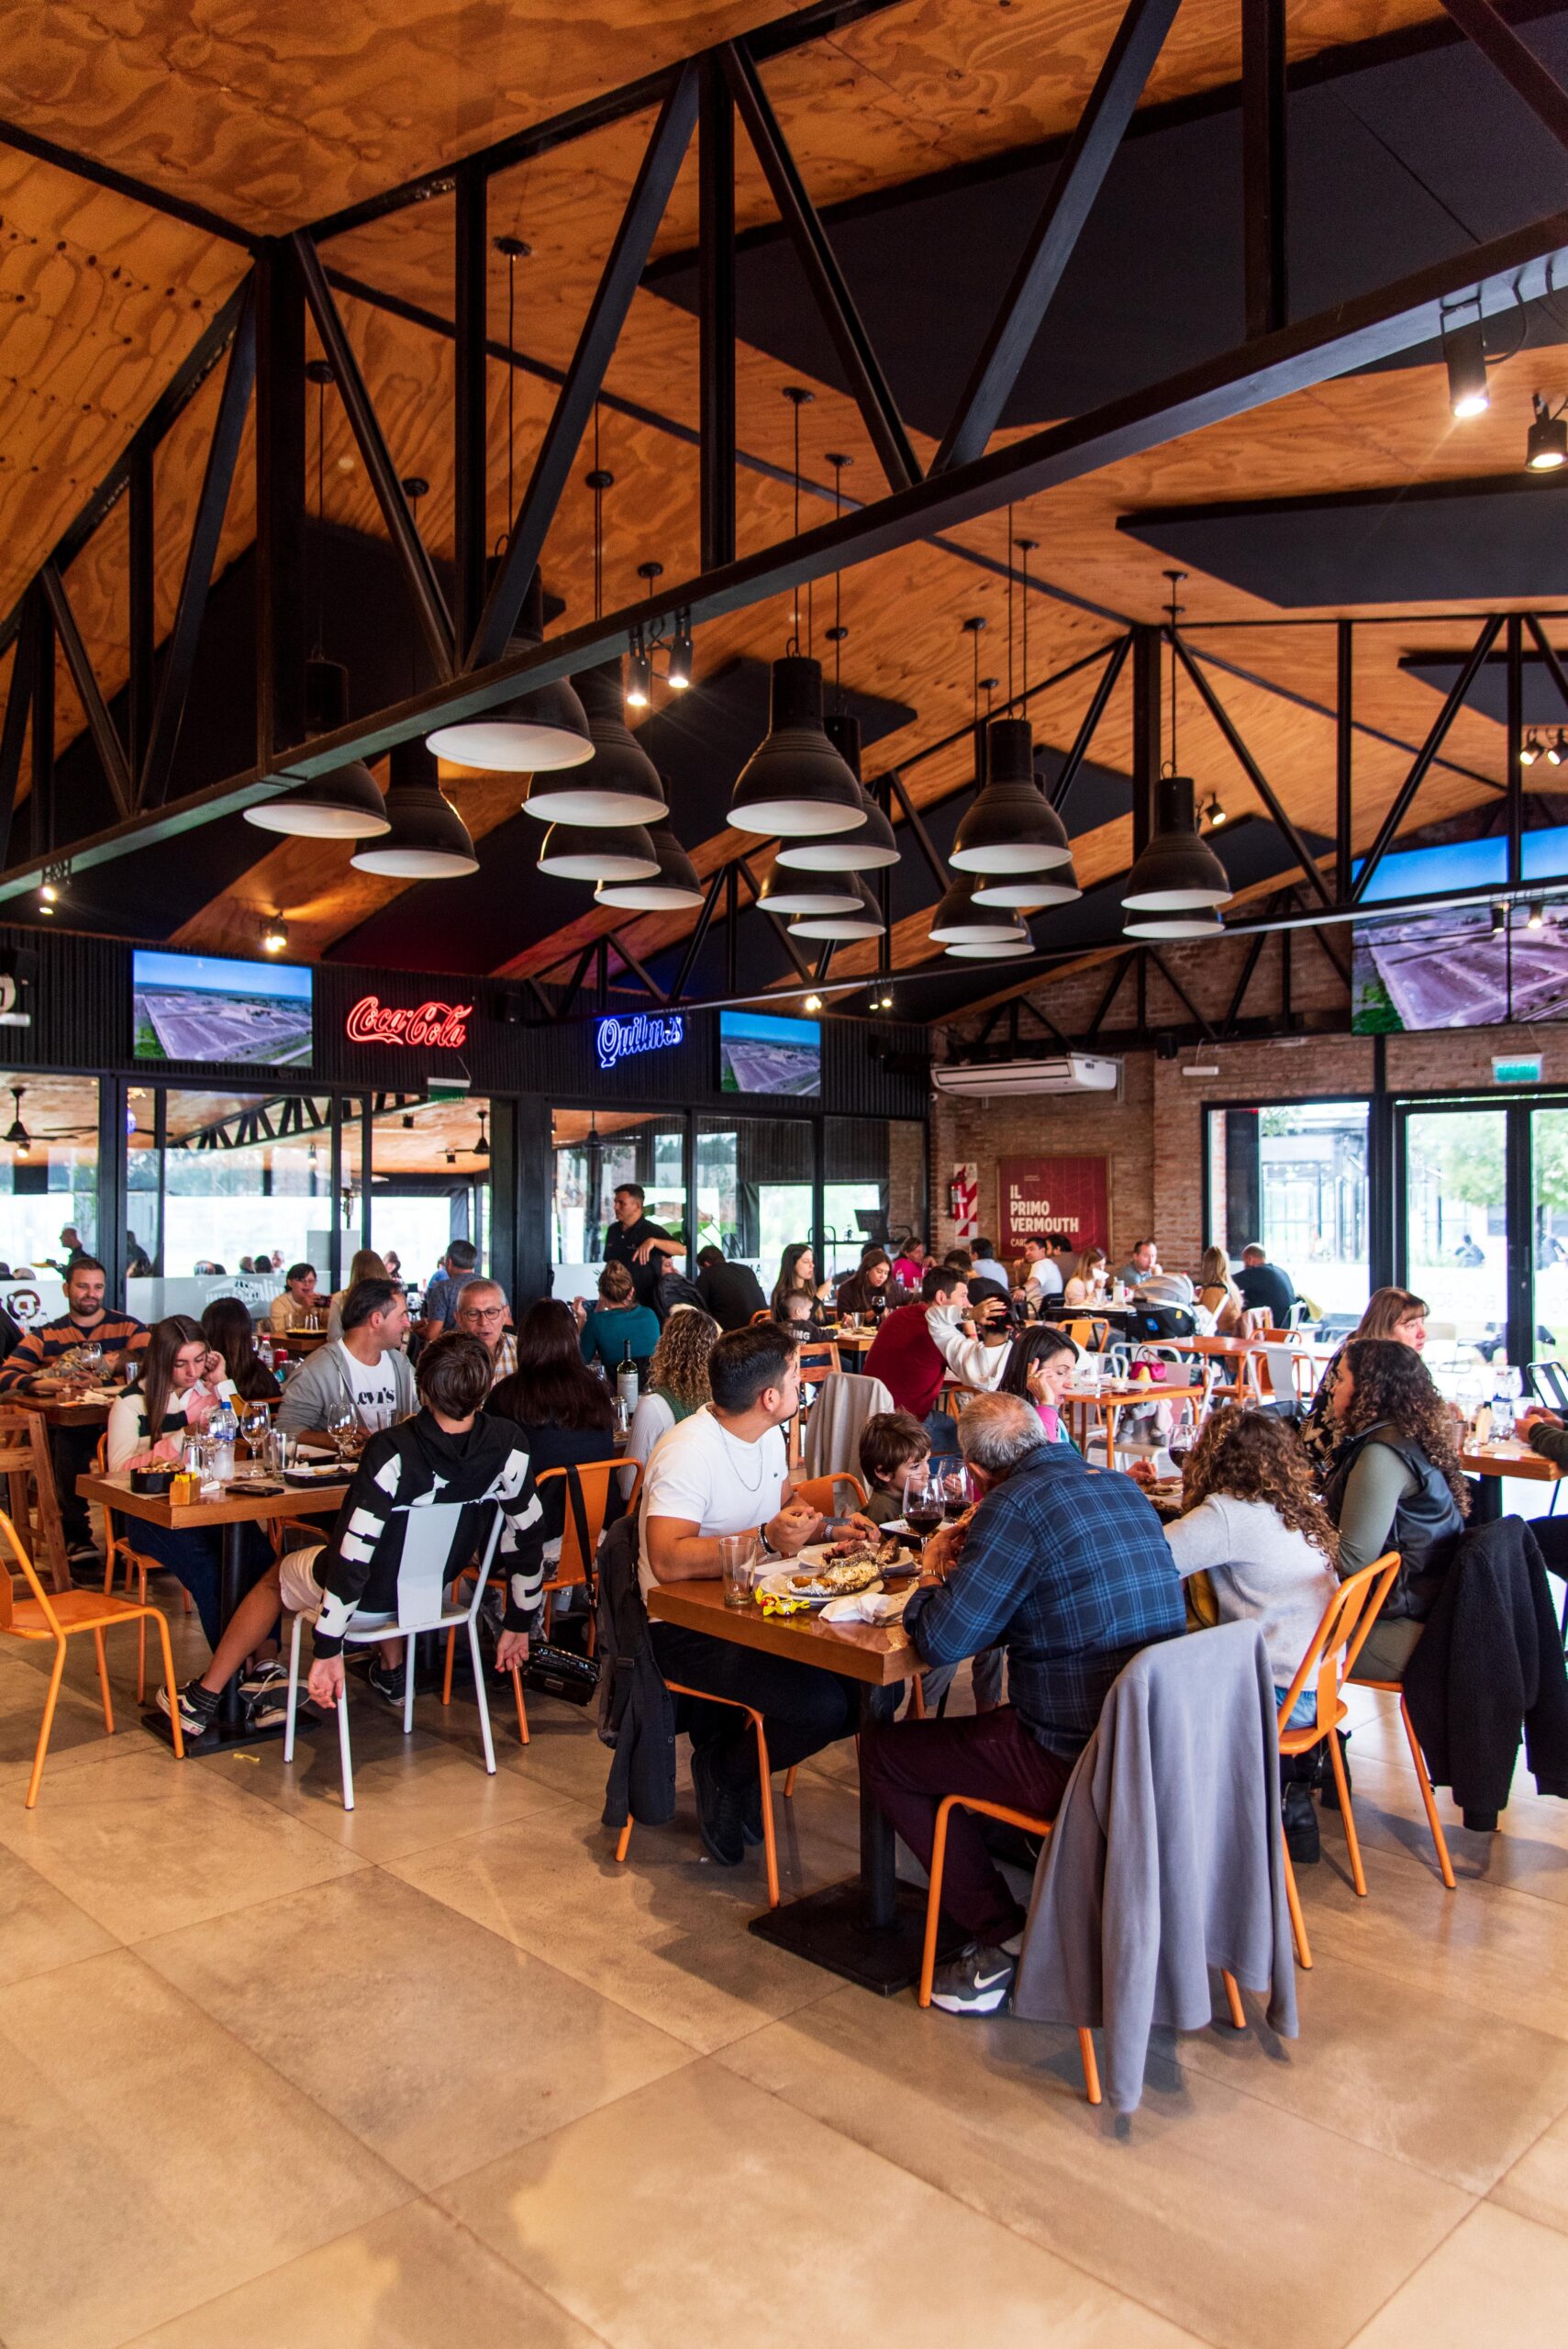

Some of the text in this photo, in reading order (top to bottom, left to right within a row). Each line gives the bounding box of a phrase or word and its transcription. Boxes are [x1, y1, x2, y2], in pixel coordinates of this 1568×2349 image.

[1010, 1185, 1021, 1199] IL
[1010, 1201, 1050, 1216] PRIMO
[1010, 1218, 1079, 1232] VERMOUTH
[357, 1386, 395, 1406] evi's
